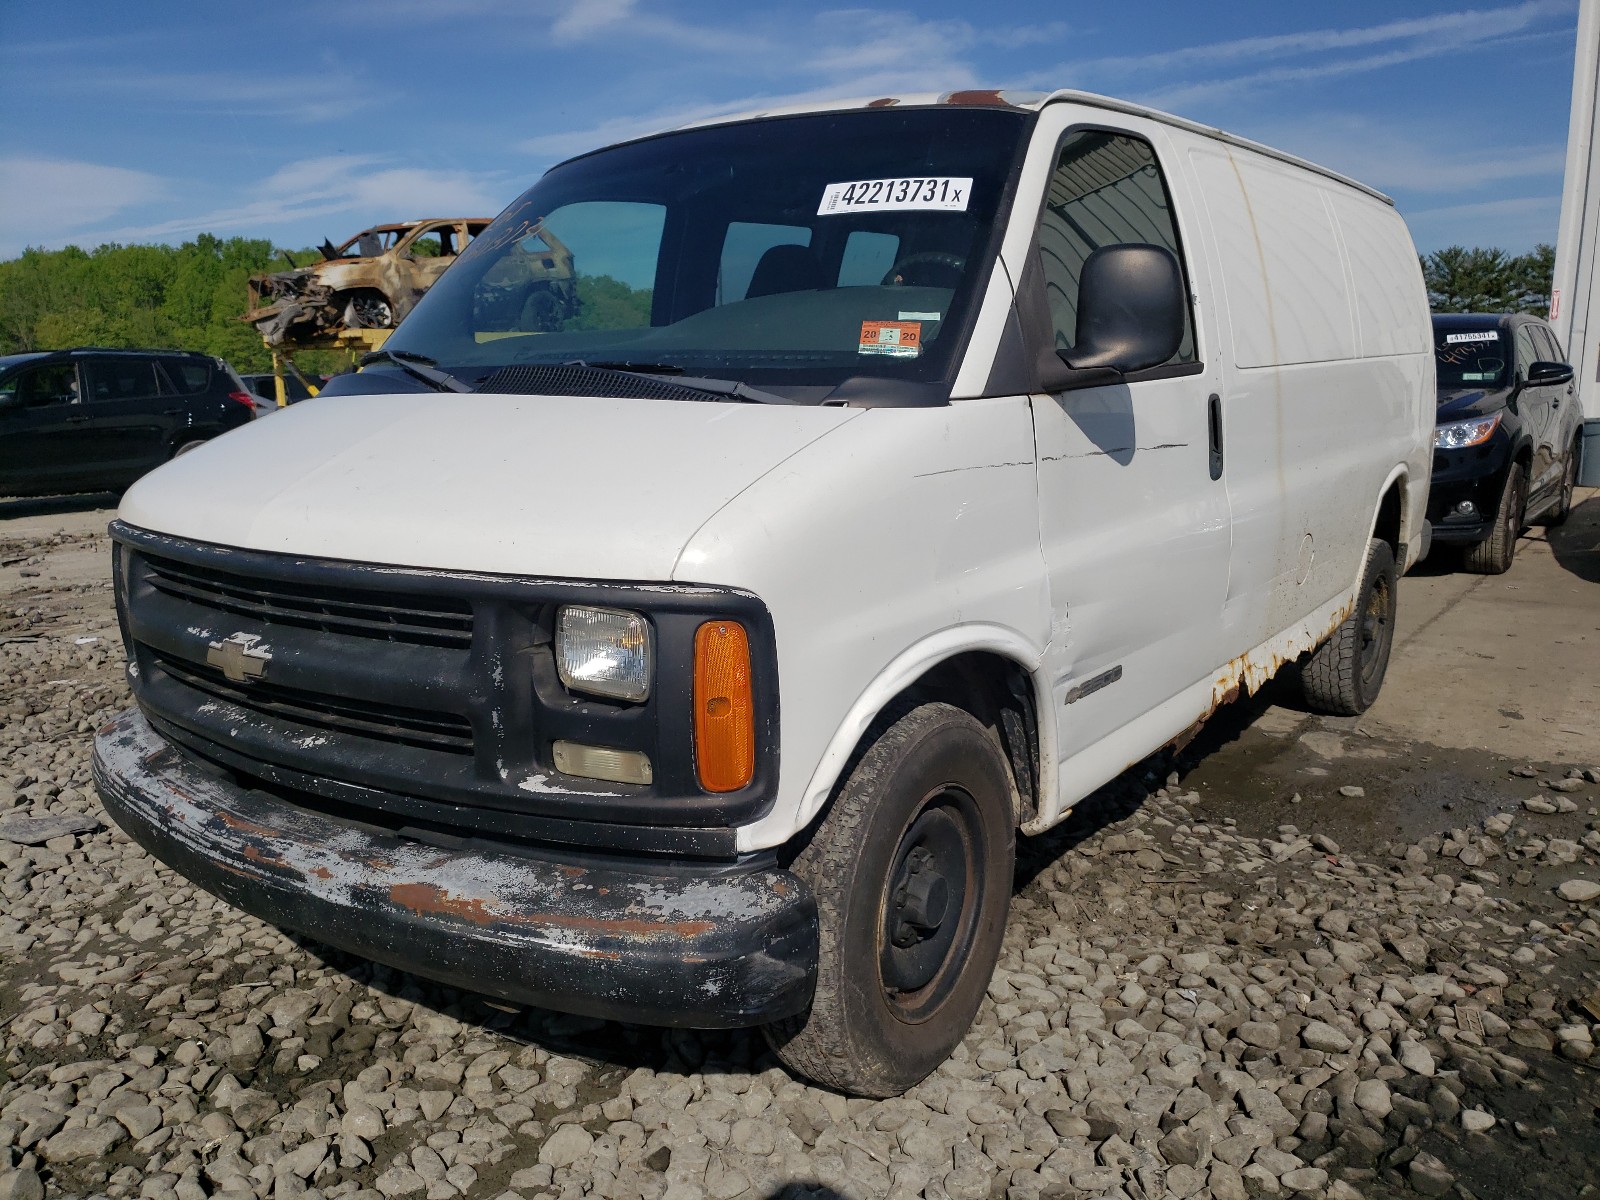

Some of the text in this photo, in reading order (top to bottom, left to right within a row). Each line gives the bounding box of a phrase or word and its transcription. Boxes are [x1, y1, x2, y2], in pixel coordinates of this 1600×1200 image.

[842, 179, 950, 205] 42213731
[864, 331, 877, 339] 20
[902, 333, 917, 341] 20
